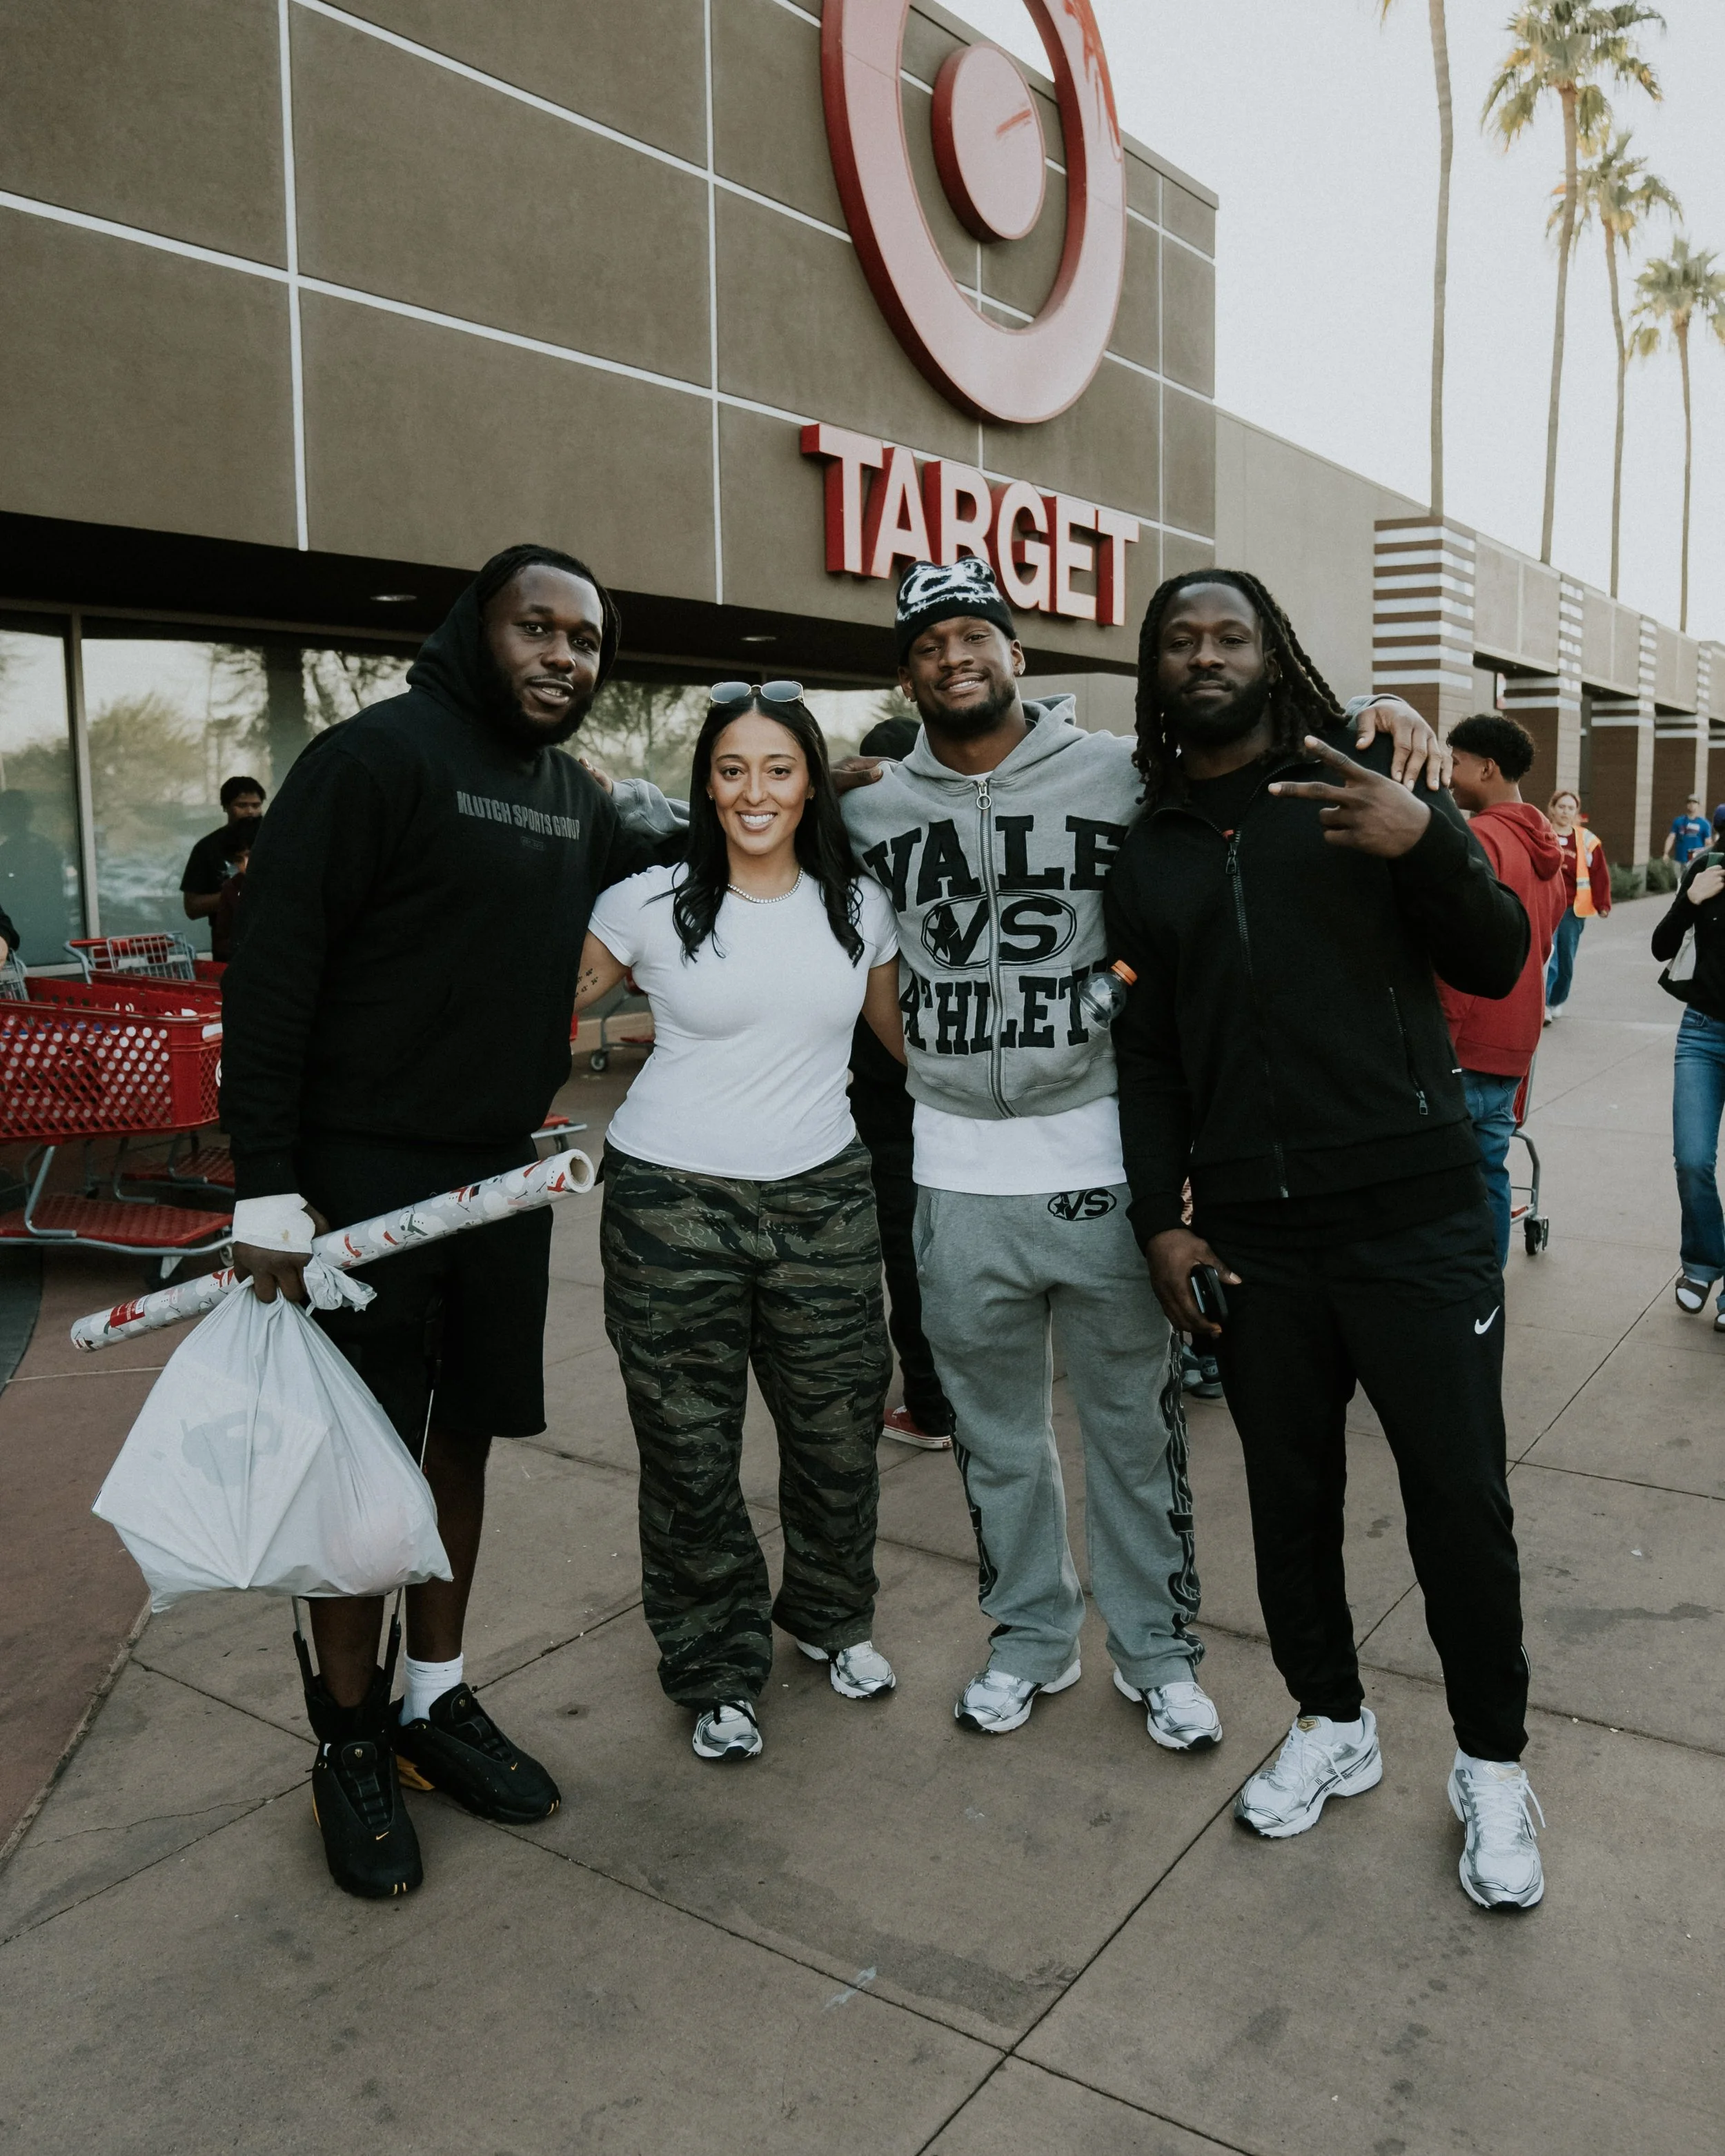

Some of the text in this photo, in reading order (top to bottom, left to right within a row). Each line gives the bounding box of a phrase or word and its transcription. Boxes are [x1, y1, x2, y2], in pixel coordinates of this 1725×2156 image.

[801, 423, 1140, 626] TARGET
[457, 791, 512, 824] KLUTCH
[512, 804, 552, 836] SPORTS
[1059, 1188, 1110, 1220] VS
